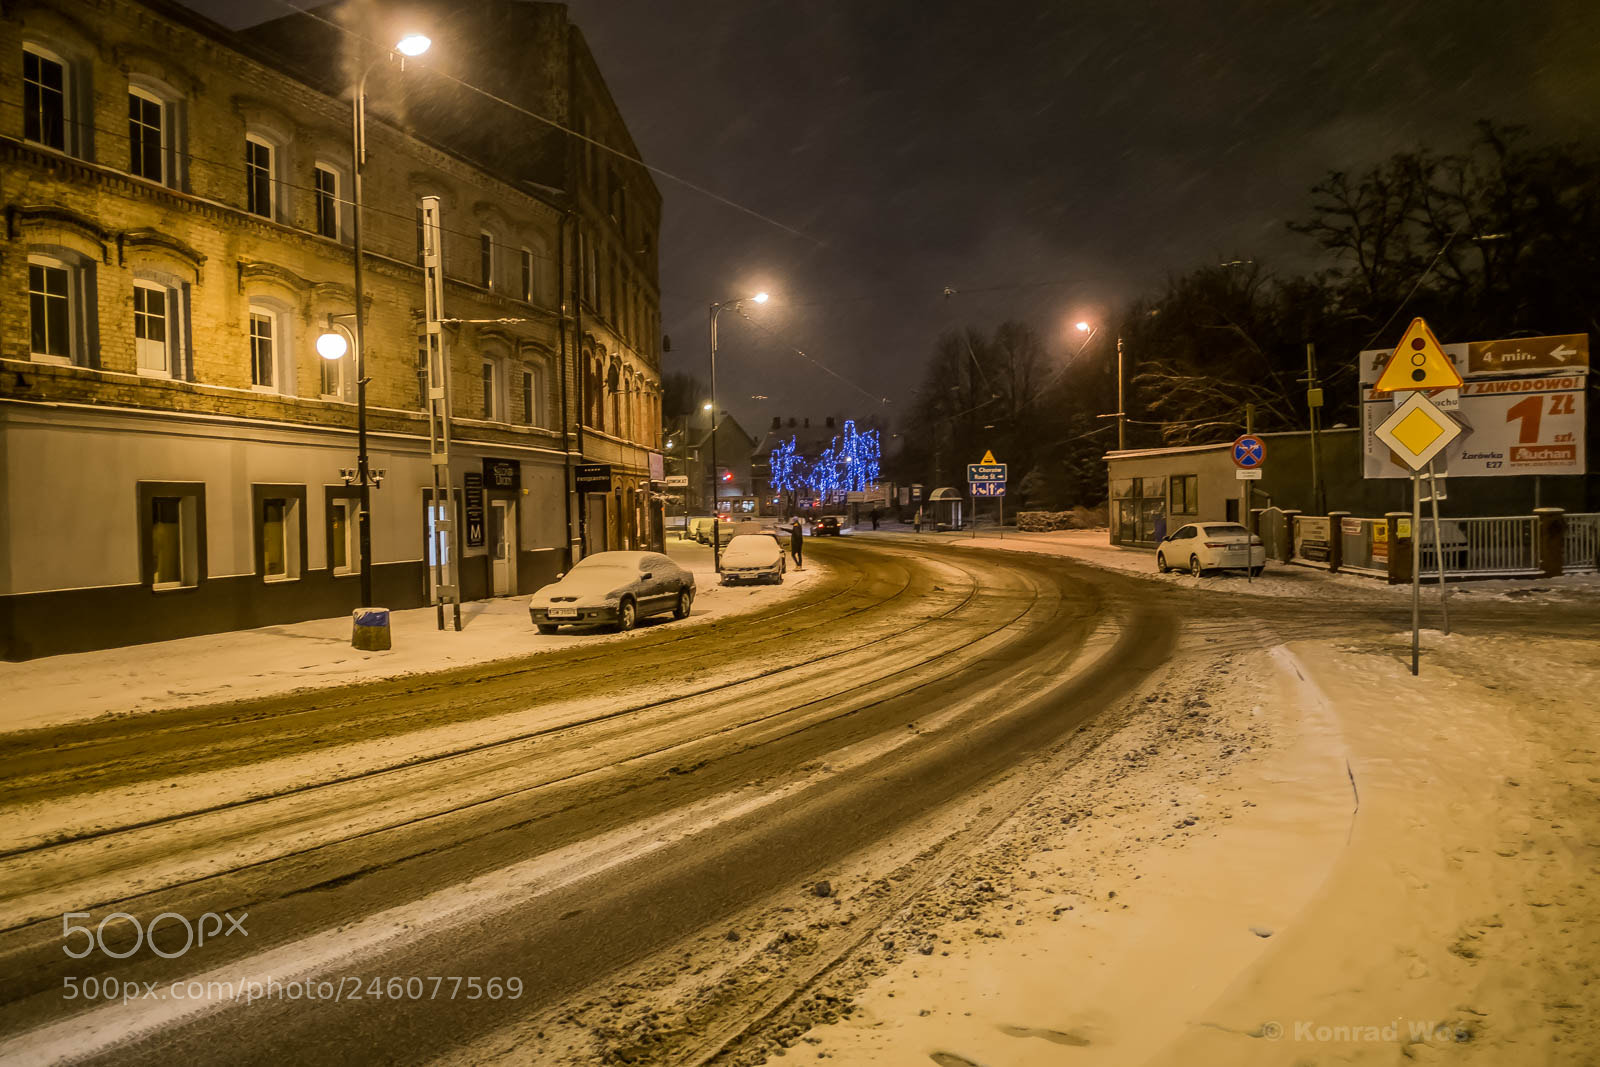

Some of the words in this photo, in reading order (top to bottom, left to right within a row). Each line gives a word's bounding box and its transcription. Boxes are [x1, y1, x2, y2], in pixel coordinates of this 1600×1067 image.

[1482, 351, 1493, 362] 4
[1501, 349, 1537, 362] min.
[1475, 377, 1580, 394] ZAWODOWO!
[1506, 396, 1544, 444] 1
[1462, 451, 1504, 460] Żarówka
[1516, 448, 1571, 460] Auchan
[1486, 461, 1503, 469] E27
